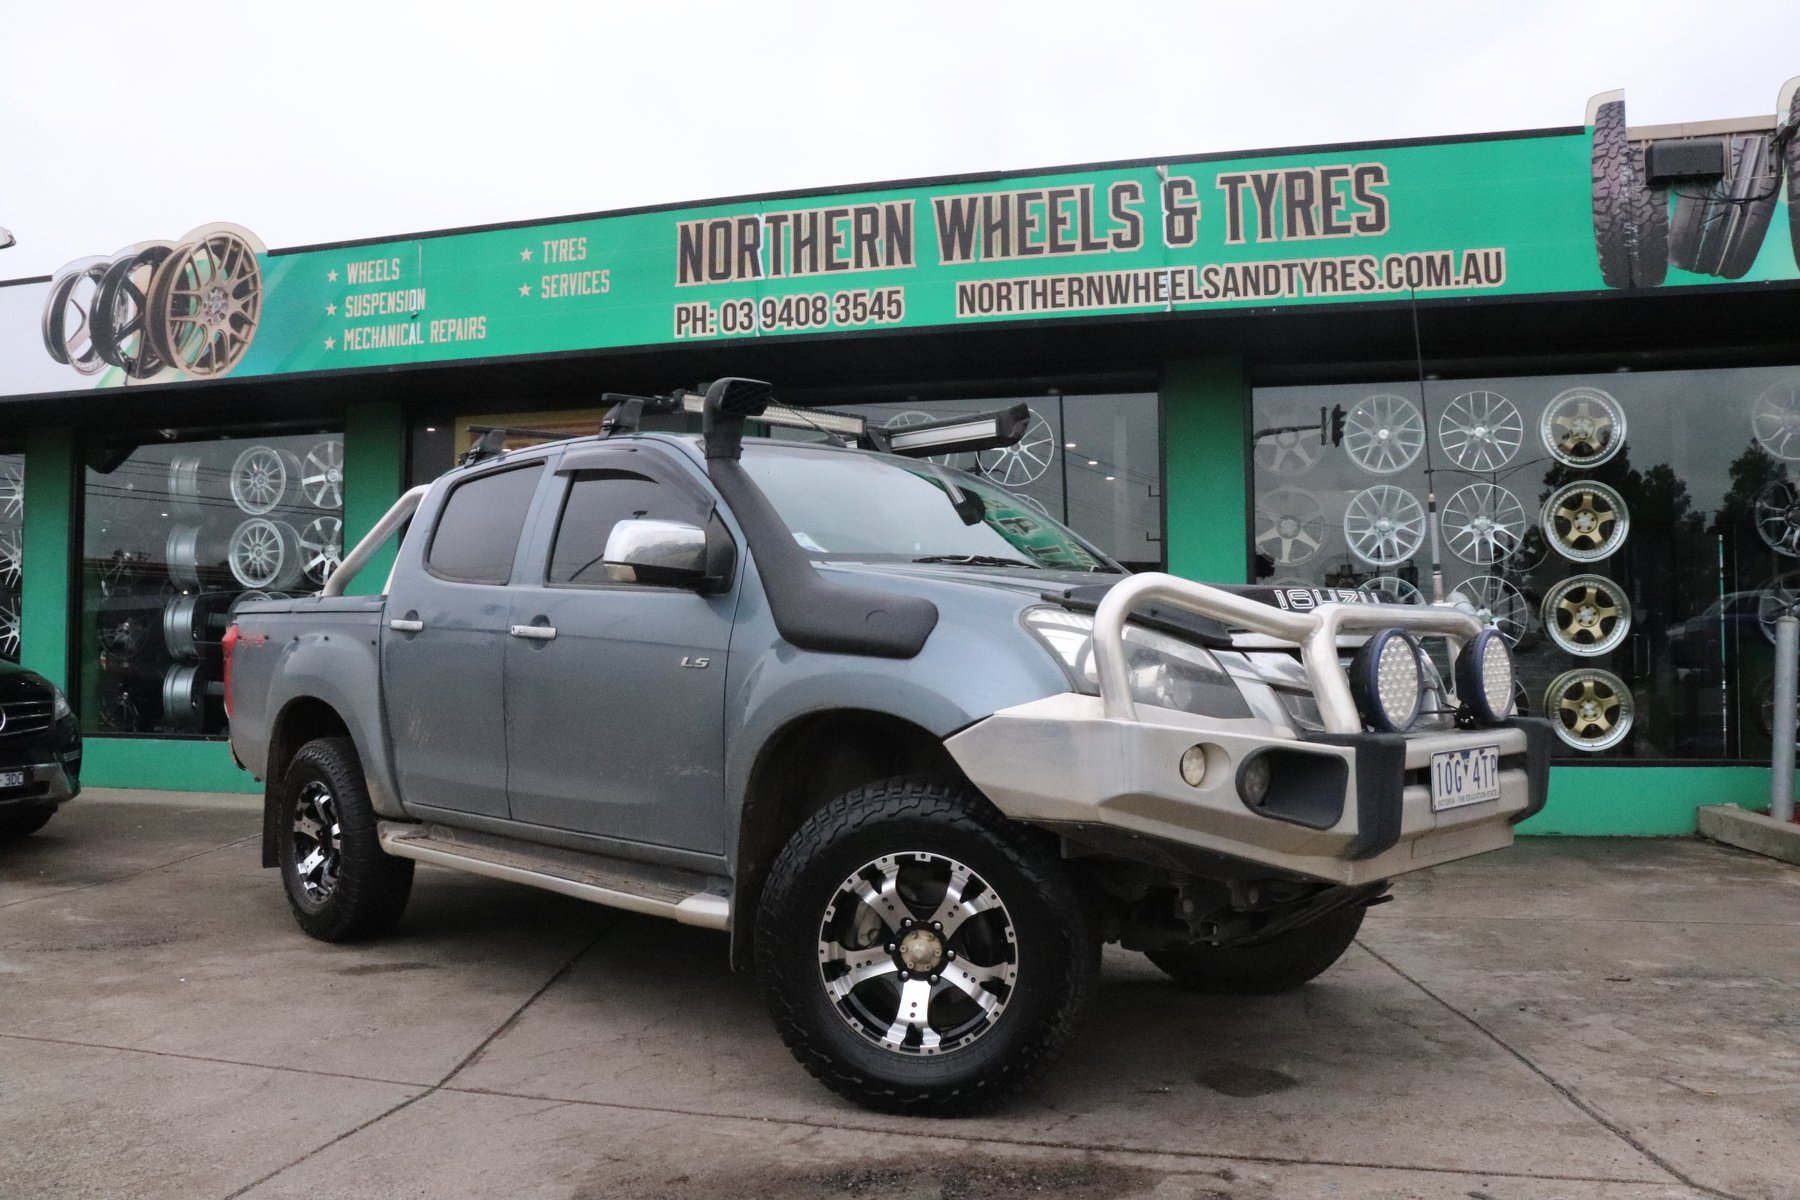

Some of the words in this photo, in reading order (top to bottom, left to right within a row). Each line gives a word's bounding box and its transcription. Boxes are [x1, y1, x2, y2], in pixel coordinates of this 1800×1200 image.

[675, 199, 916, 287] NORTHERN
[931, 180, 1144, 265] WHEELS
[1163, 176, 1200, 249] &
[1216, 161, 1390, 245] TYRES
[543, 237, 588, 264] TYRES
[347, 258, 400, 285] WHEELS
[541, 269, 611, 299] SERVICES
[957, 249, 1505, 318] NORTHERNWHEELSANDTYRES.COM.AU
[345, 288, 425, 318] SUSPENSION
[675, 303, 717, 337] PH:
[720, 299, 756, 335] 03
[759, 293, 829, 331] 9408
[833, 286, 905, 326] 3545
[343, 322, 424, 351] MECHANICAL
[430, 316, 487, 343] REPAIRS
[681, 656, 710, 668] LS
[1473, 754, 1497, 789] 4TP
